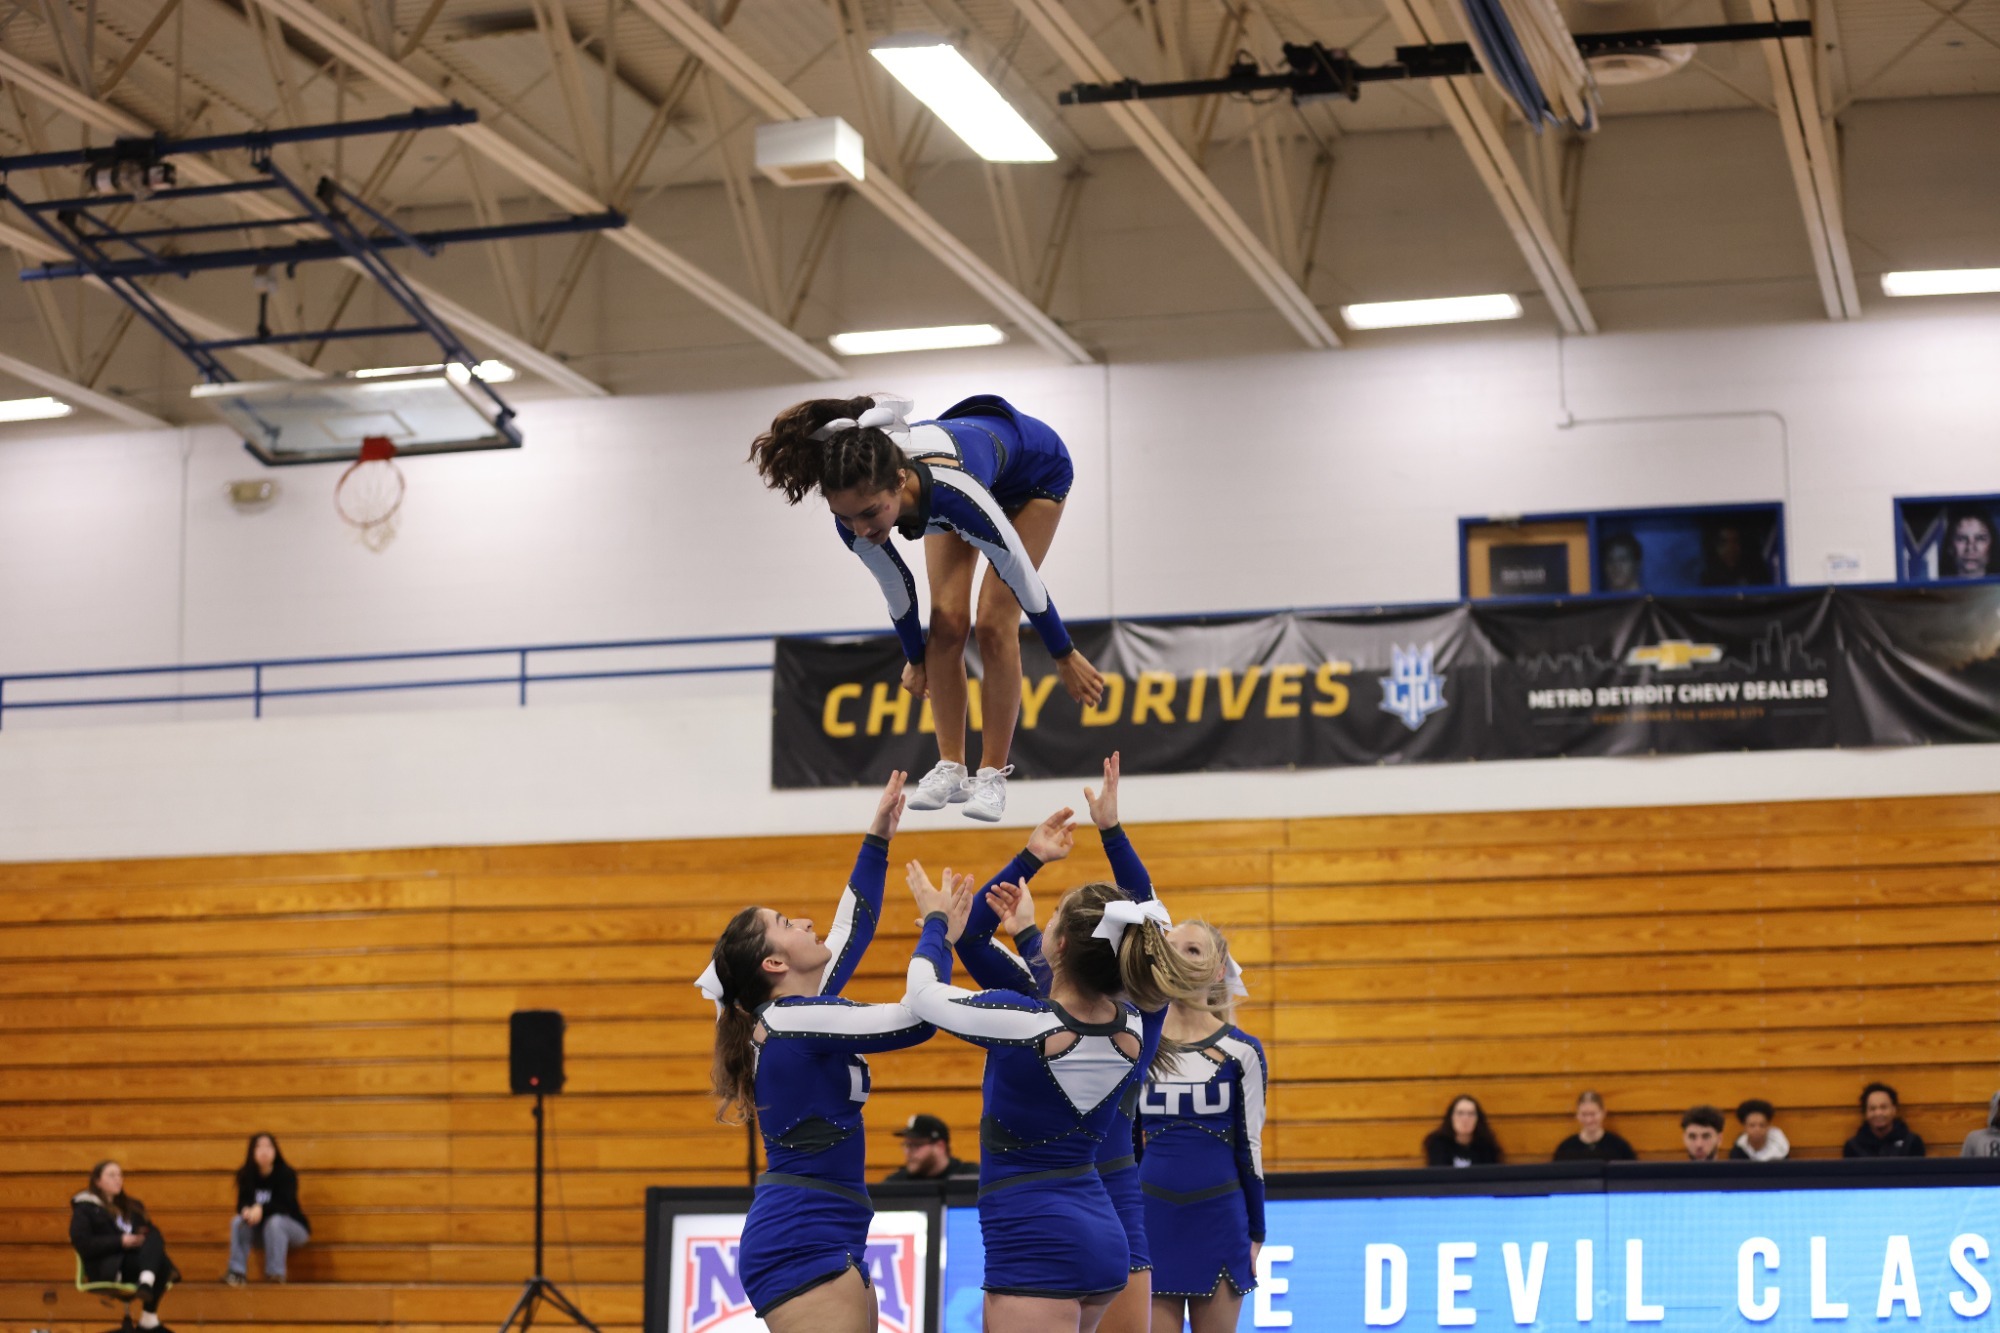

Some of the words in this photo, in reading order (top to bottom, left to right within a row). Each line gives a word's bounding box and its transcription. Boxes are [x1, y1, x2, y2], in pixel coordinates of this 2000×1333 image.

[823, 674, 1060, 737] CHY
[1081, 661, 1352, 727] DRIVES
[1528, 688, 1593, 709] METRO
[1597, 684, 1674, 706] DETROIT
[1678, 682, 1739, 703] CHEVY
[1743, 679, 1828, 700] DEALERS
[1139, 1082, 1230, 1115] LTU
[692, 1244, 915, 1325] NA
[1364, 1239, 1664, 1326] DEVIL
[1737, 1233, 1992, 1322] CLAS
